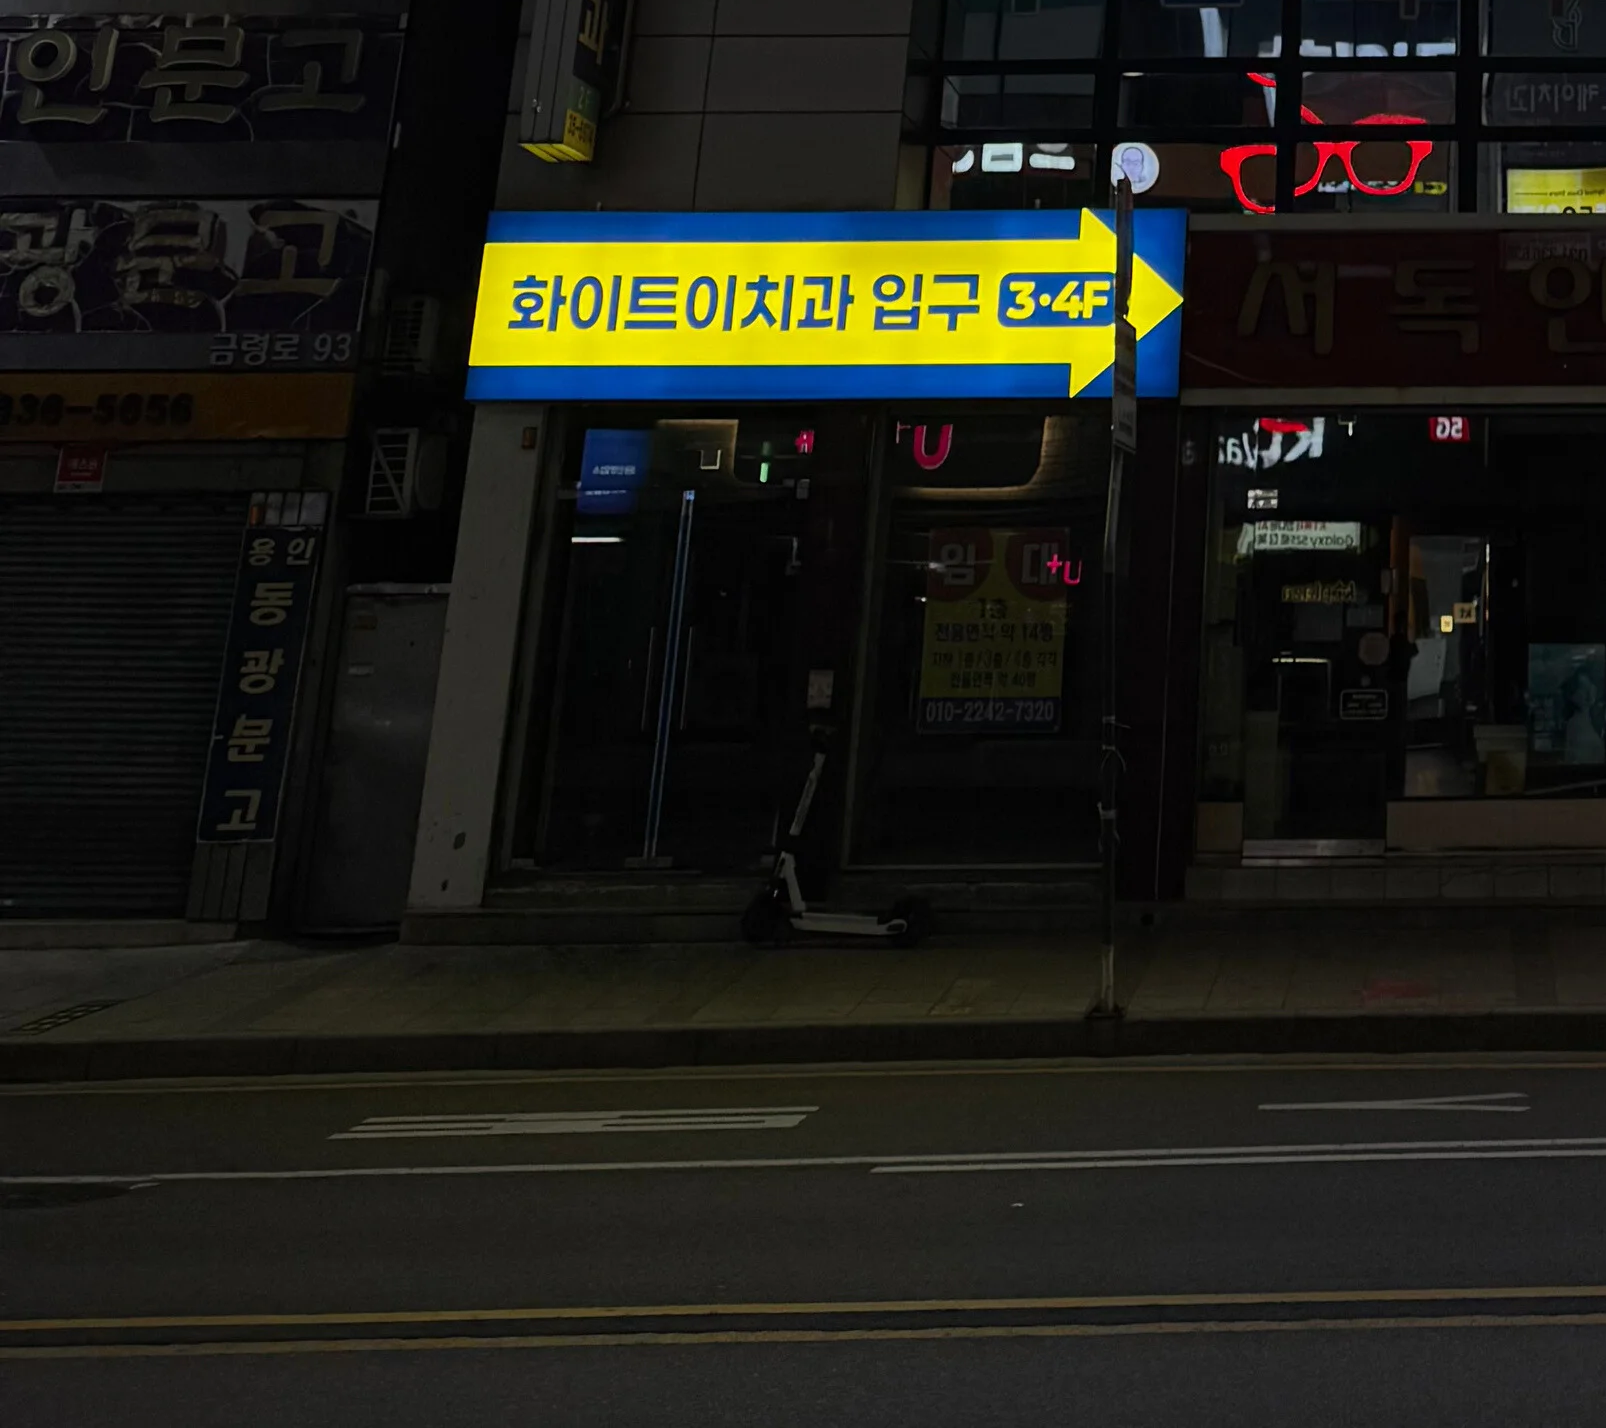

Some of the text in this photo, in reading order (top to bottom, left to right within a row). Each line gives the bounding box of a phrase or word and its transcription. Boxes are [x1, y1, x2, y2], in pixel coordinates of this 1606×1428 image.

[507, 274, 854, 332] 화이트이치과
[872, 274, 981, 331] 입구
[312, 332, 352, 363] 93
[215, 580, 296, 833] 동광문고
